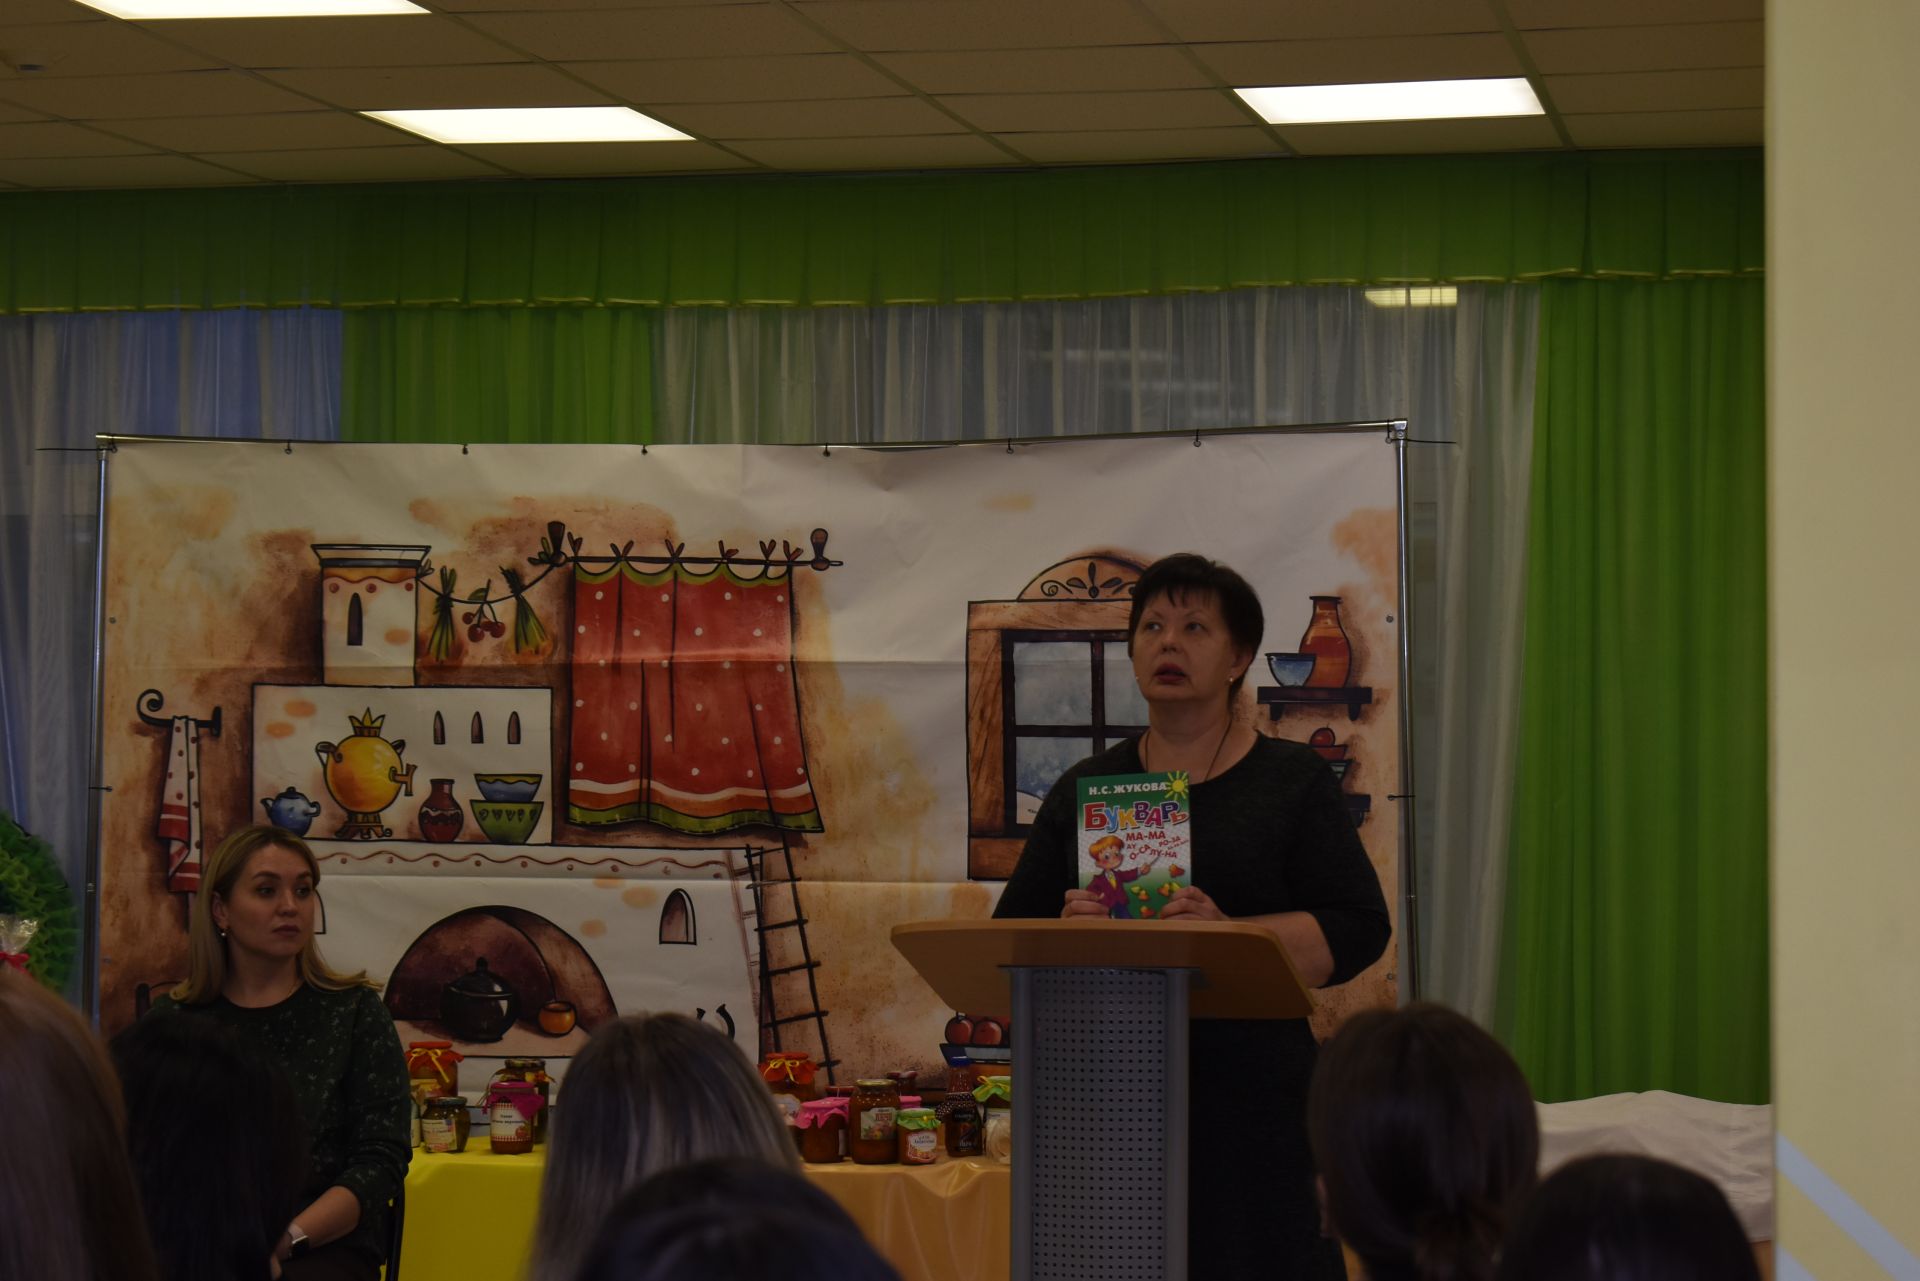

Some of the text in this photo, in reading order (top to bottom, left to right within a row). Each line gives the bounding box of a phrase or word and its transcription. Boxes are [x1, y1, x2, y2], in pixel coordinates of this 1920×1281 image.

[1089, 782, 1168, 795] Н.С. ЖУКОВА
[1126, 831, 1165, 841] МА-МА
[1130, 844, 1151, 860] О-СА
[1150, 849, 1177, 858] ЛУ-НА
